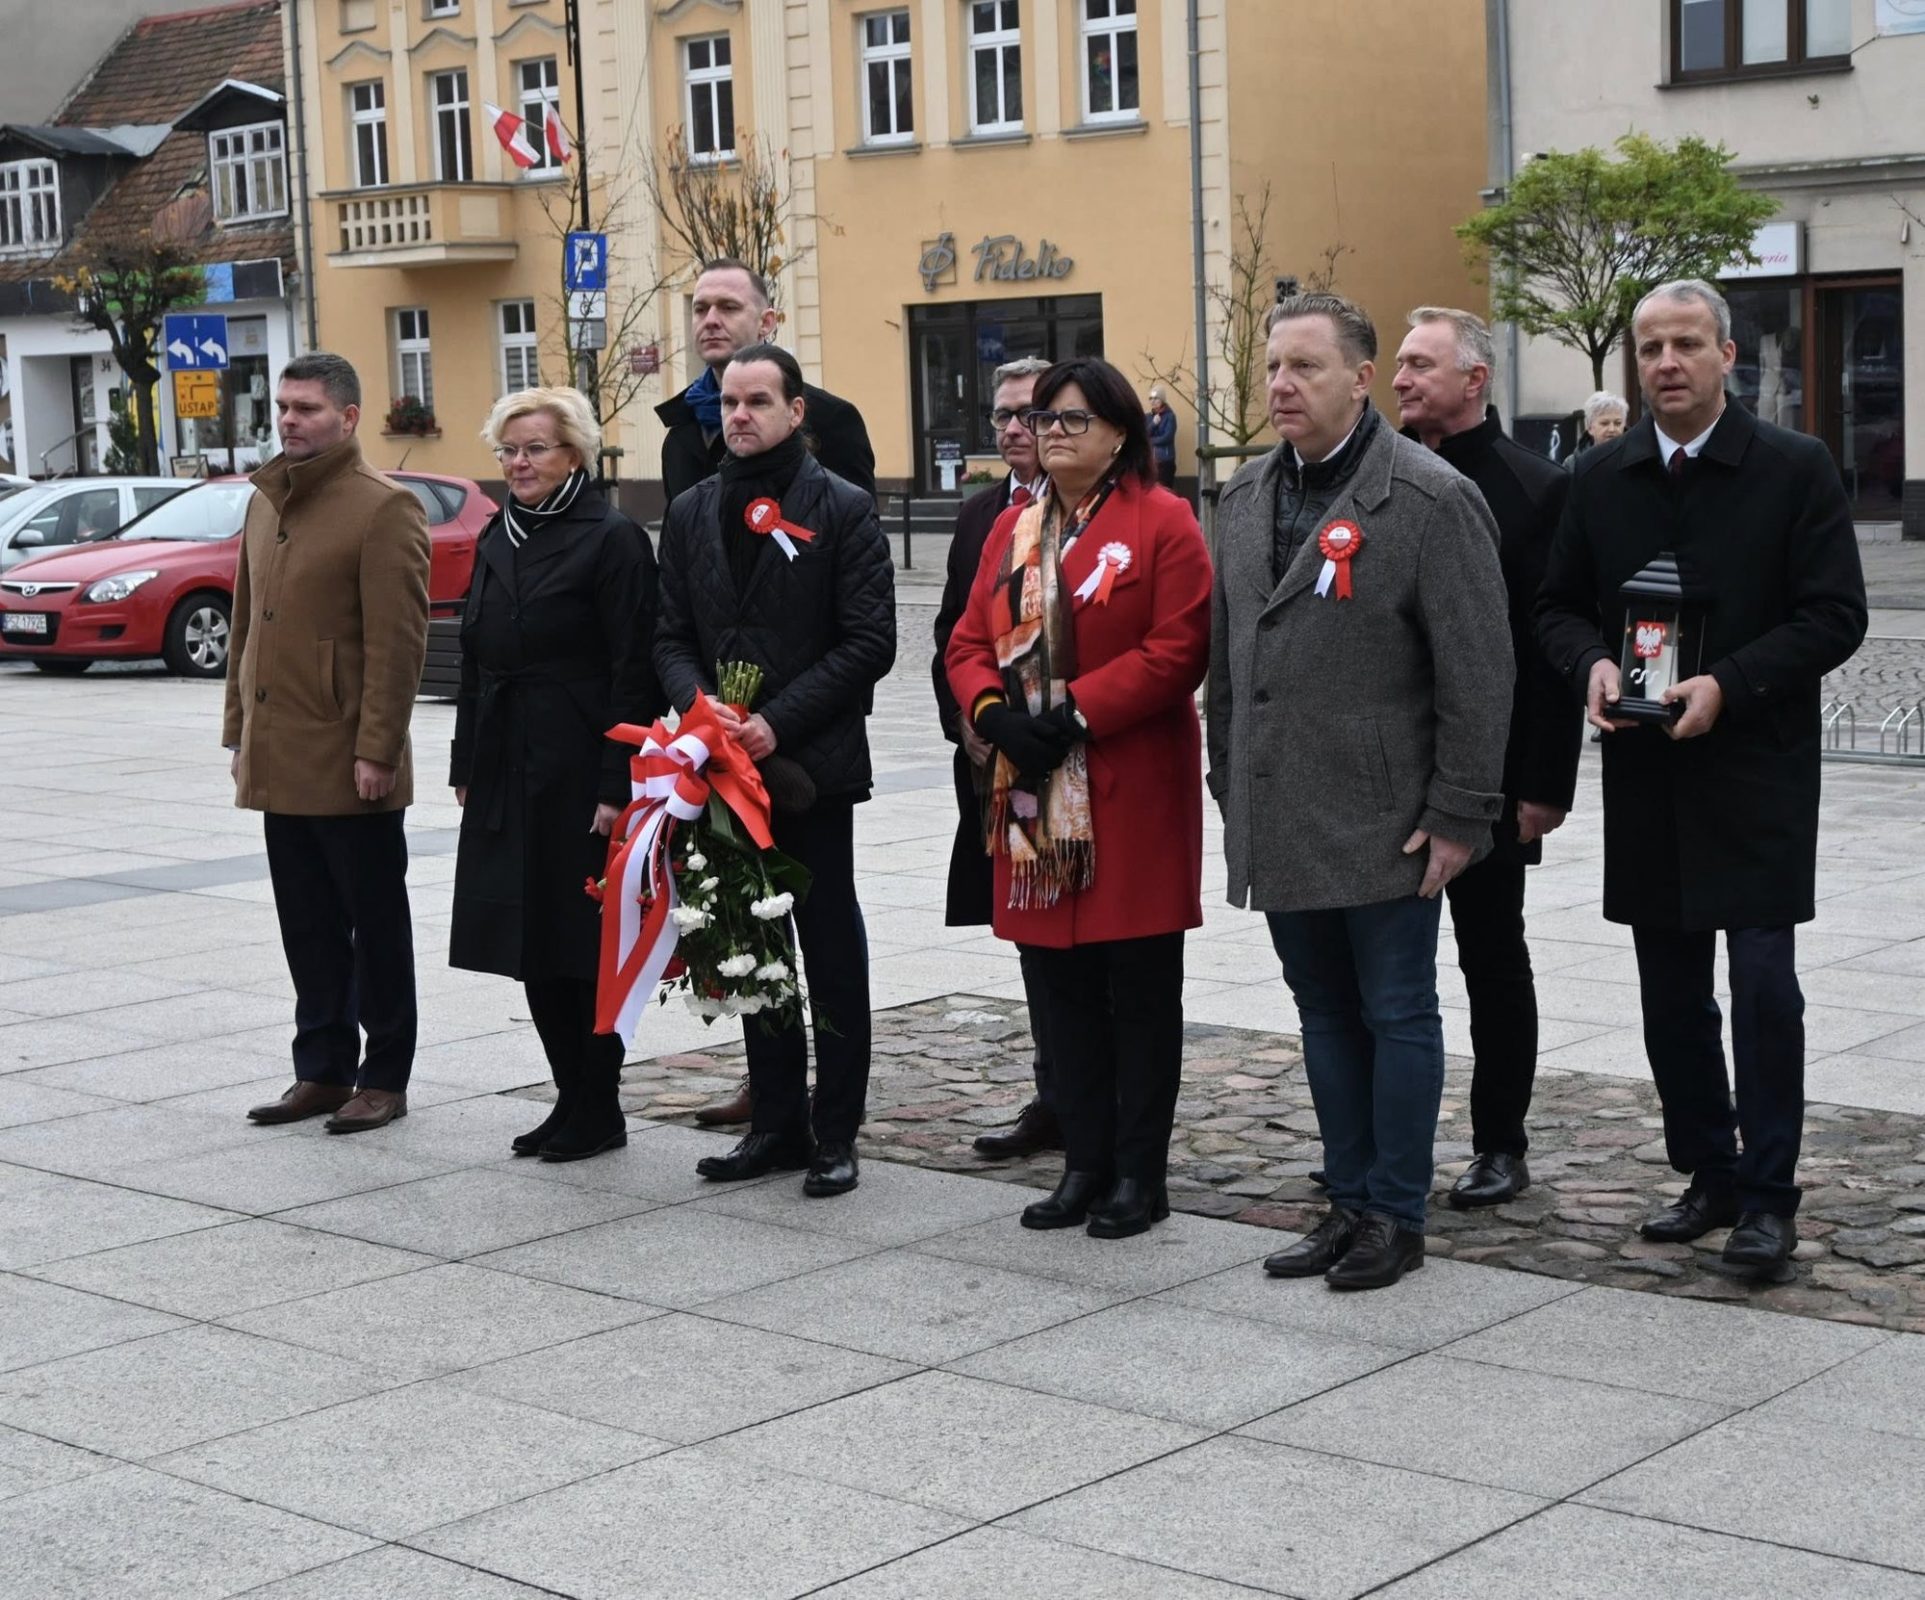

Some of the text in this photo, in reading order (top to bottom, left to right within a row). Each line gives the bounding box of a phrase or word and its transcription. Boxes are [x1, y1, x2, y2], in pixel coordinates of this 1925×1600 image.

[574, 238, 598, 283] P
[971, 234, 1074, 281] Fidelio
[101, 358, 111, 372] 34
